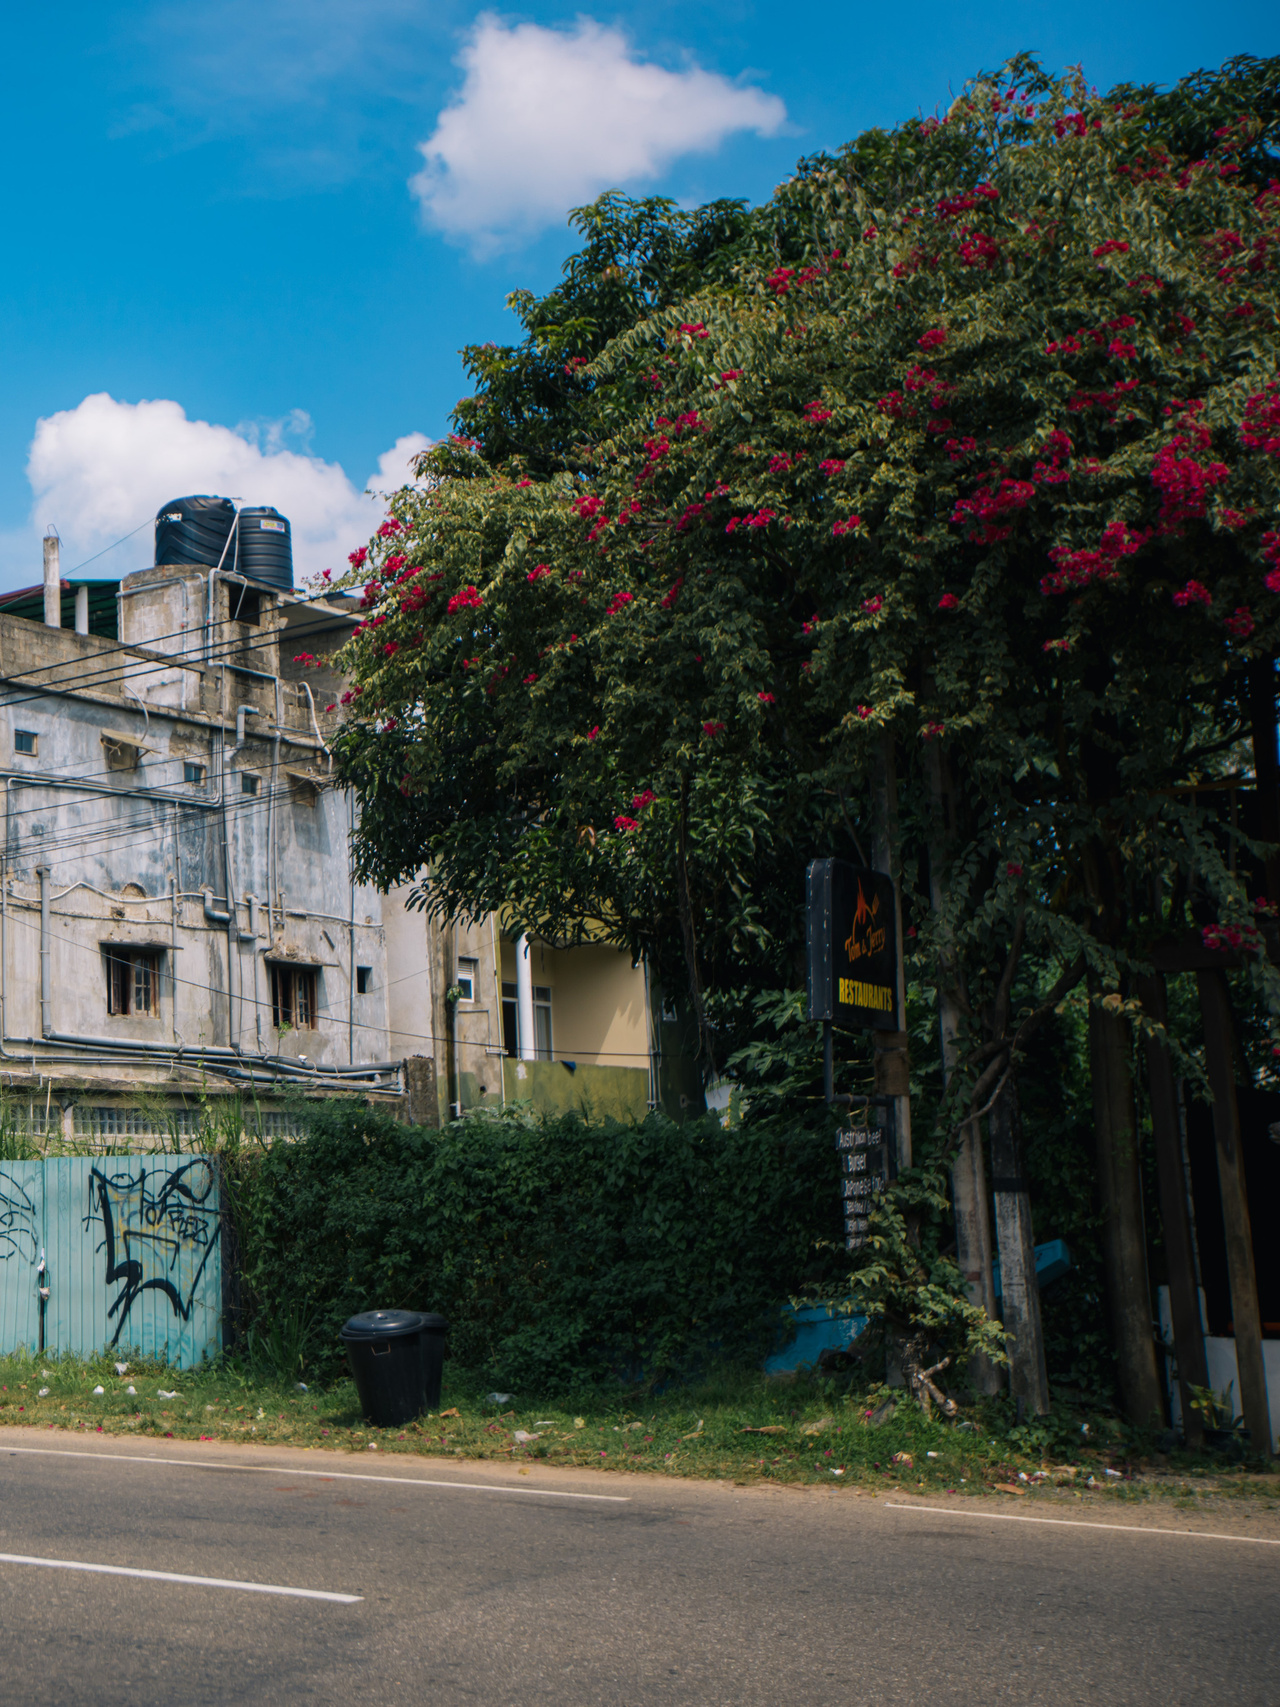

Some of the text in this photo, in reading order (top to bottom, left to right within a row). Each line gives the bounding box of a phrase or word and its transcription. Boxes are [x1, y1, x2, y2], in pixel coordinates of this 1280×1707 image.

[844, 935, 862, 964] Tom
[866, 924, 886, 958] Jerry
[838, 976, 893, 1013] RESTAURANTS
